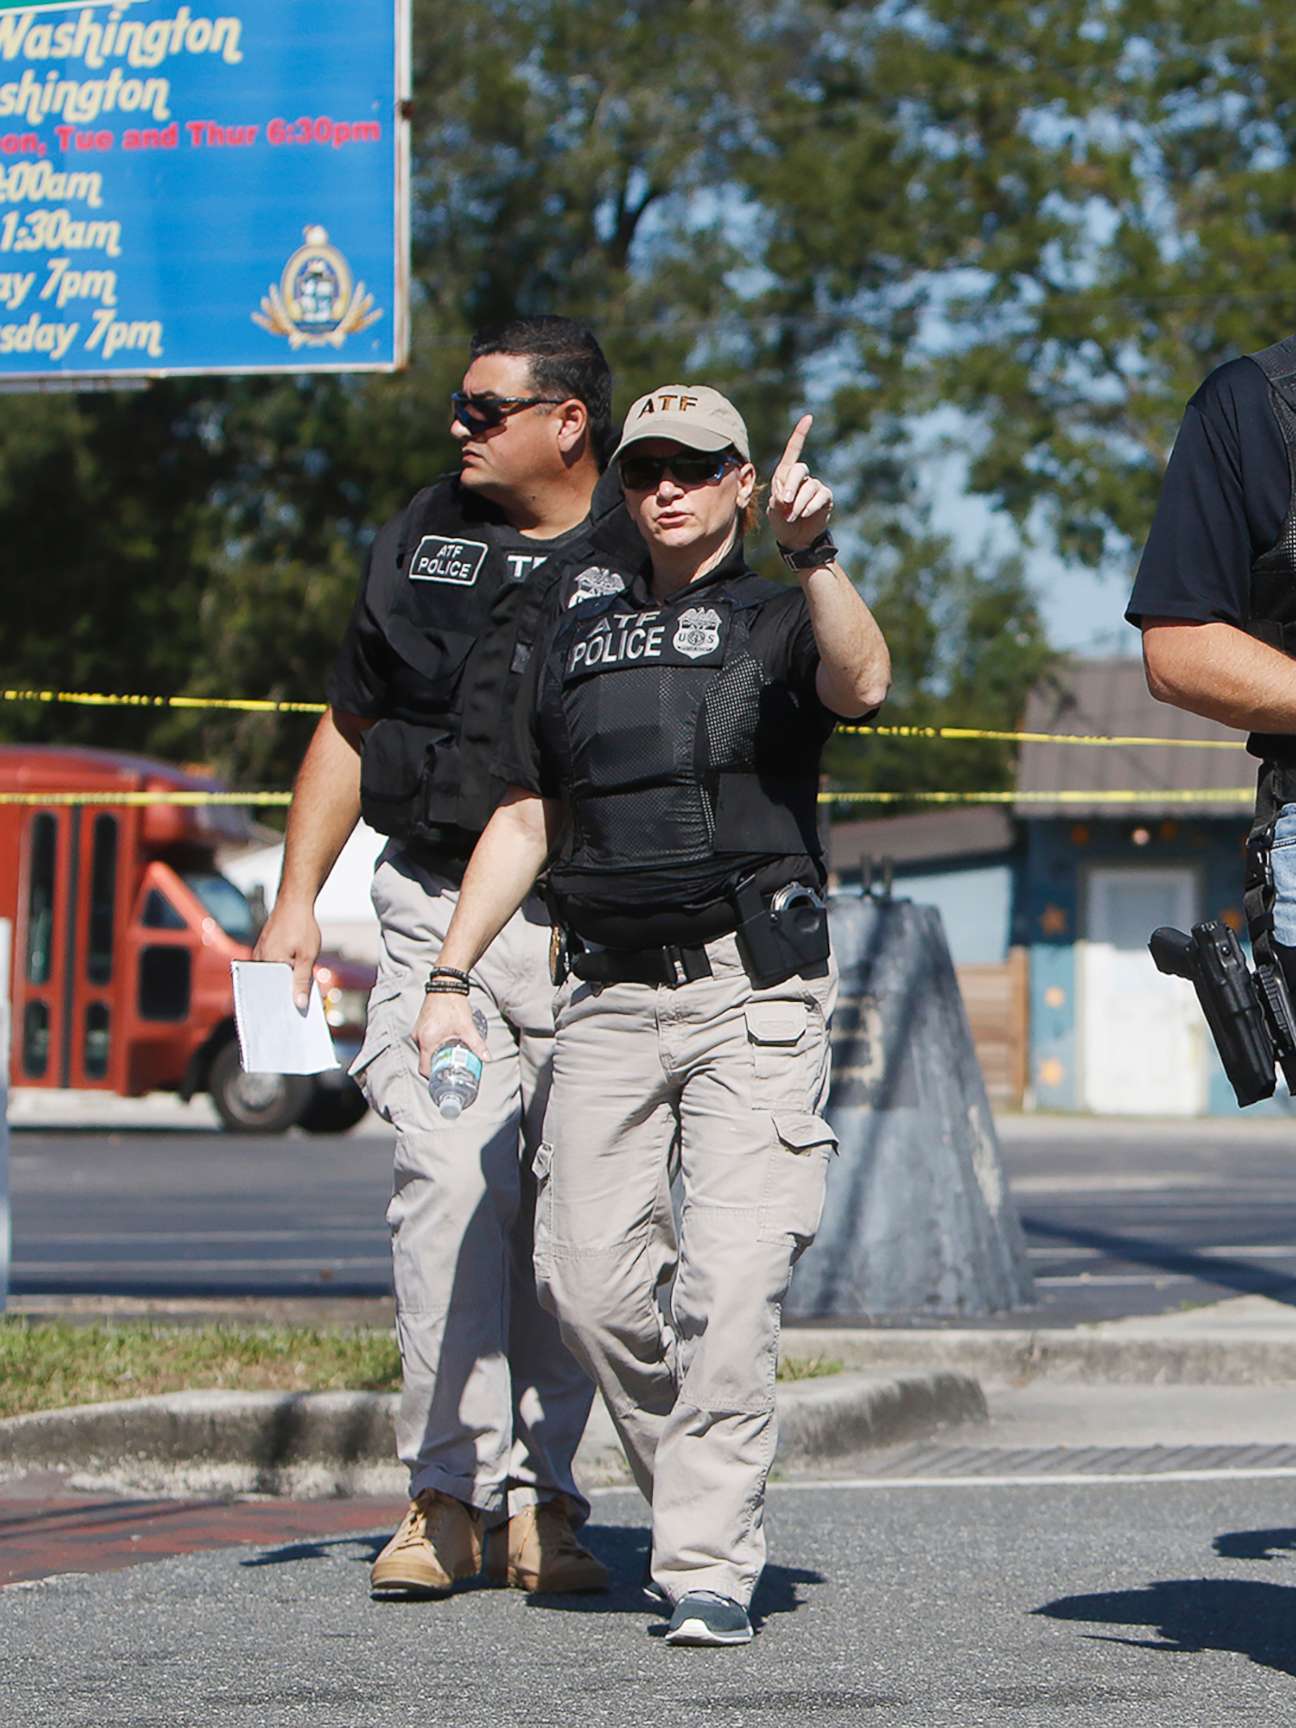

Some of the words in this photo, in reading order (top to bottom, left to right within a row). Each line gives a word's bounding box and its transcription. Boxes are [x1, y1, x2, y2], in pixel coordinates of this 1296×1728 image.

[0, 6, 244, 69] Washington
[54, 124, 115, 151] Tue
[122, 121, 179, 150] and
[185, 119, 258, 147] Thur
[266, 115, 382, 149] 6:30pm
[0, 160, 103, 208] :00am
[39, 257, 117, 308] 7pm
[83, 308, 163, 358] 7pm
[636, 394, 699, 419] ATF
[417, 557, 472, 578] POLICE
[436, 544, 463, 558] ATF
[586, 611, 661, 639] ATF
[569, 625, 666, 673] POLICE
